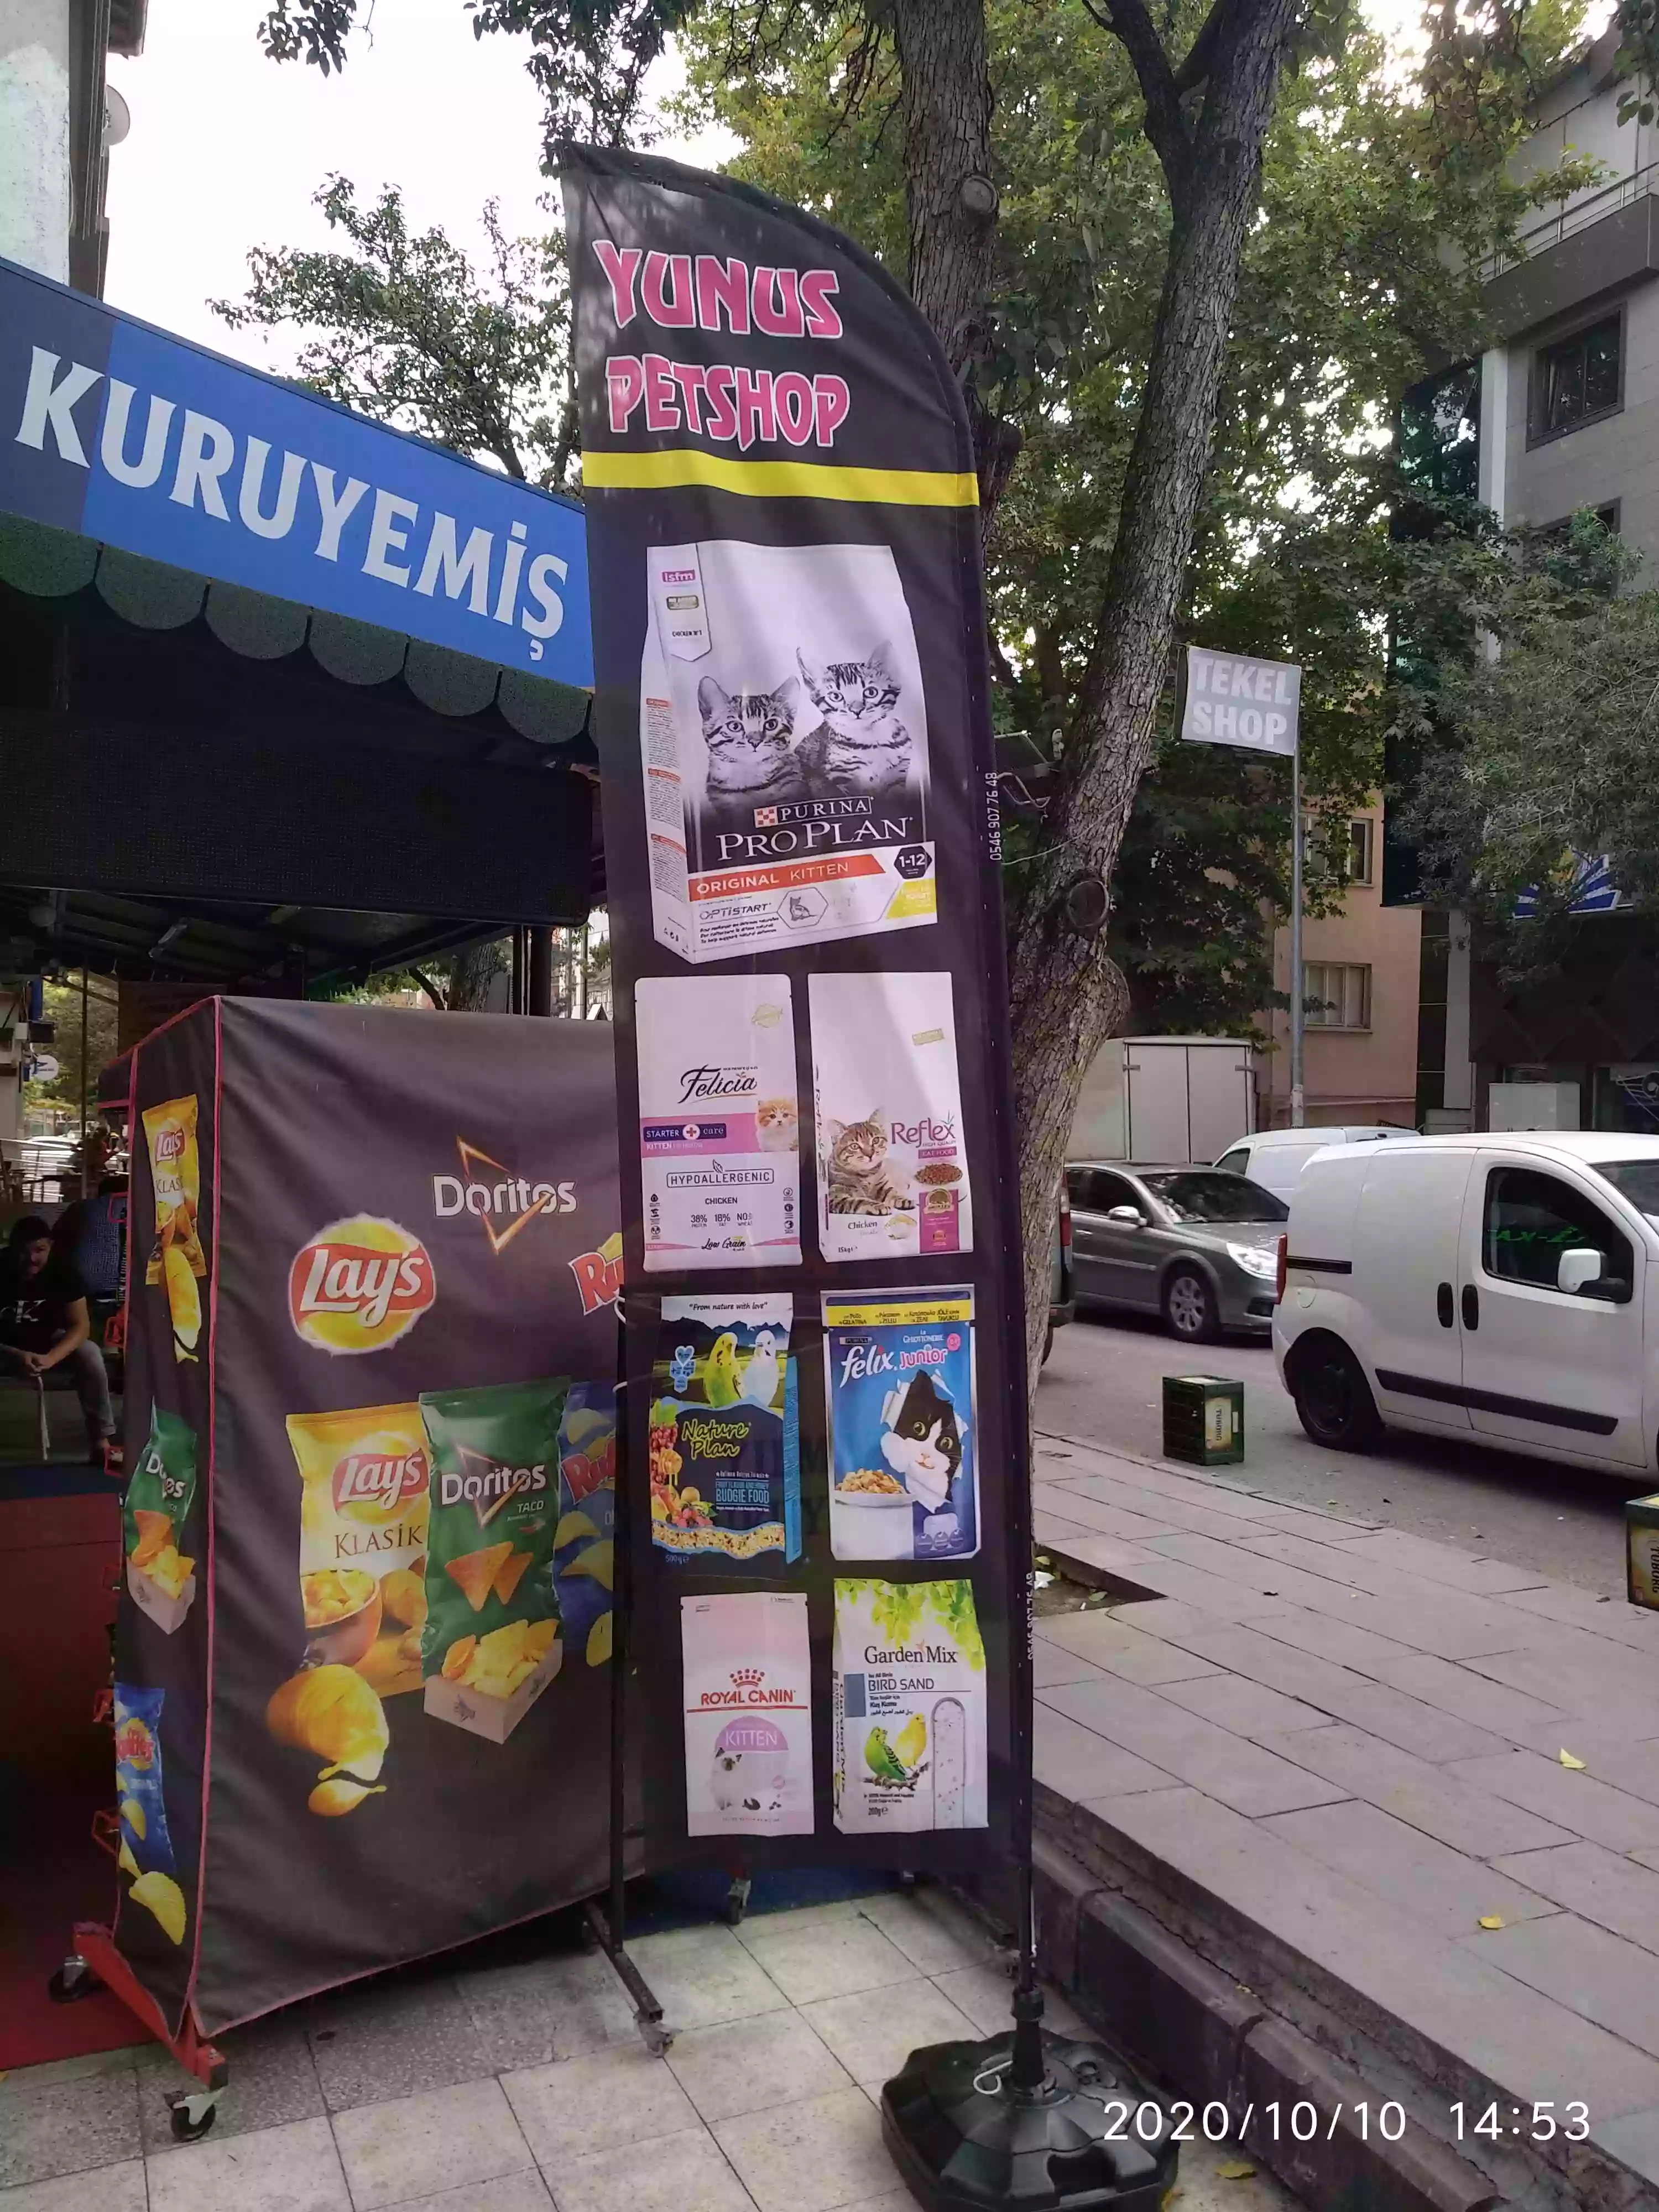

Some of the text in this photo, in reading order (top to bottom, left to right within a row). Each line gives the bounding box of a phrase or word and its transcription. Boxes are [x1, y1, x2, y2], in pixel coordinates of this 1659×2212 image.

[592, 239, 844, 340] YUNUS
[605, 353, 851, 452] PETSHOP
[14, 345, 568, 662] KURUYEMİŞ
[1192, 656, 1292, 706] TEKEL
[1192, 701, 1287, 745] SHOP
[781, 800, 867, 822] PURINA
[985, 772, 1001, 860] 0546 907 76 48
[899, 853, 926, 868] 1-12
[697, 862, 849, 894] ORIGINAL KITTEN
[677, 1064, 758, 1104] Felicia
[646, 1129, 680, 1138] STARTER
[891, 1117, 956, 1148] Reflex
[670, 1172, 770, 1185] HYPOALLERGENIC
[432, 1173, 578, 1218] Doritos
[705, 1197, 738, 1205] CHICKEN
[691, 1214, 708, 1223] 38%
[714, 1213, 731, 1222] 18%
[848, 1219, 878, 1229] Chicken
[701, 1237, 747, 1250] Low Grain
[299, 1248, 425, 1328] Lay's
[839, 1345, 894, 1388] felix
[681, 1418, 749, 1442] Nature
[691, 1439, 741, 1460] Plan
[337, 1454, 423, 1510] Lay's
[442, 1463, 546, 1506] Doritos
[517, 1500, 545, 1514] TACO
[716, 1488, 770, 1504] BUDGIE FOOD
[334, 1524, 423, 1559] KLASİK
[864, 1646, 958, 1664] Garden Mix
[701, 1688, 794, 1705] ROYAL CANIN
[868, 1678, 935, 1691] BIRD SAND
[726, 1730, 778, 1746] KITTEN
